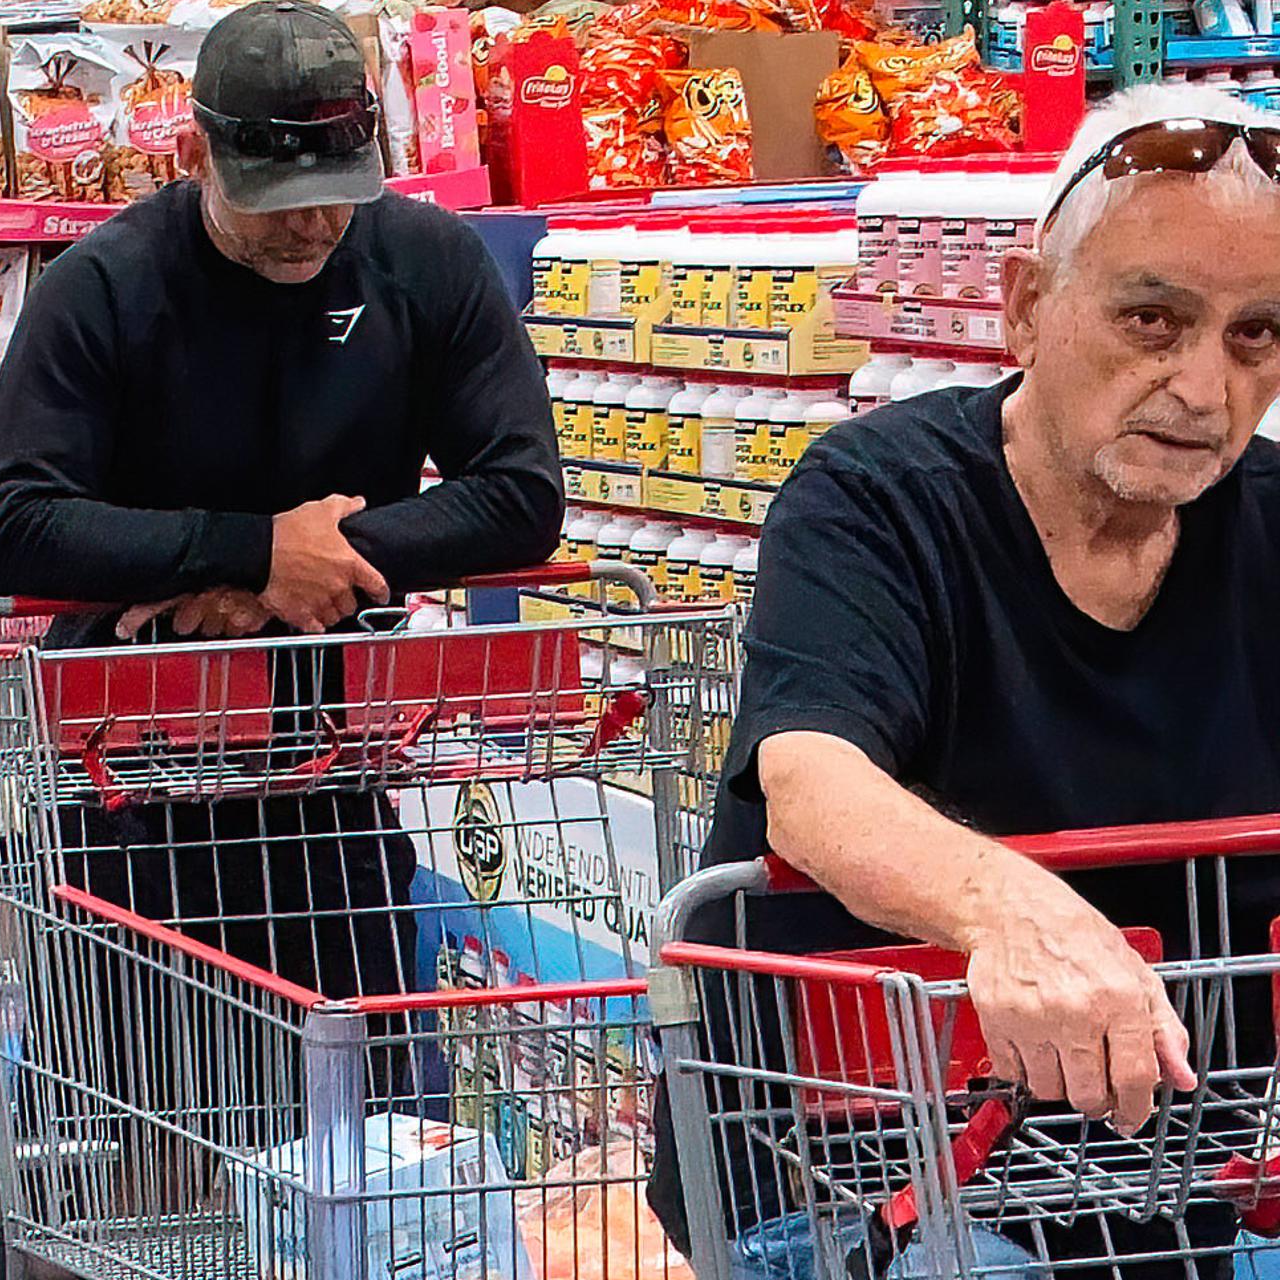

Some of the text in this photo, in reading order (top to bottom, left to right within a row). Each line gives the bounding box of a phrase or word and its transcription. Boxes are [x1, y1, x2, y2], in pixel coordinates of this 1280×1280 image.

[441, 92, 455, 149] Berry
[43, 216, 101, 236] Stra
[603, 901, 650, 947] QUA
